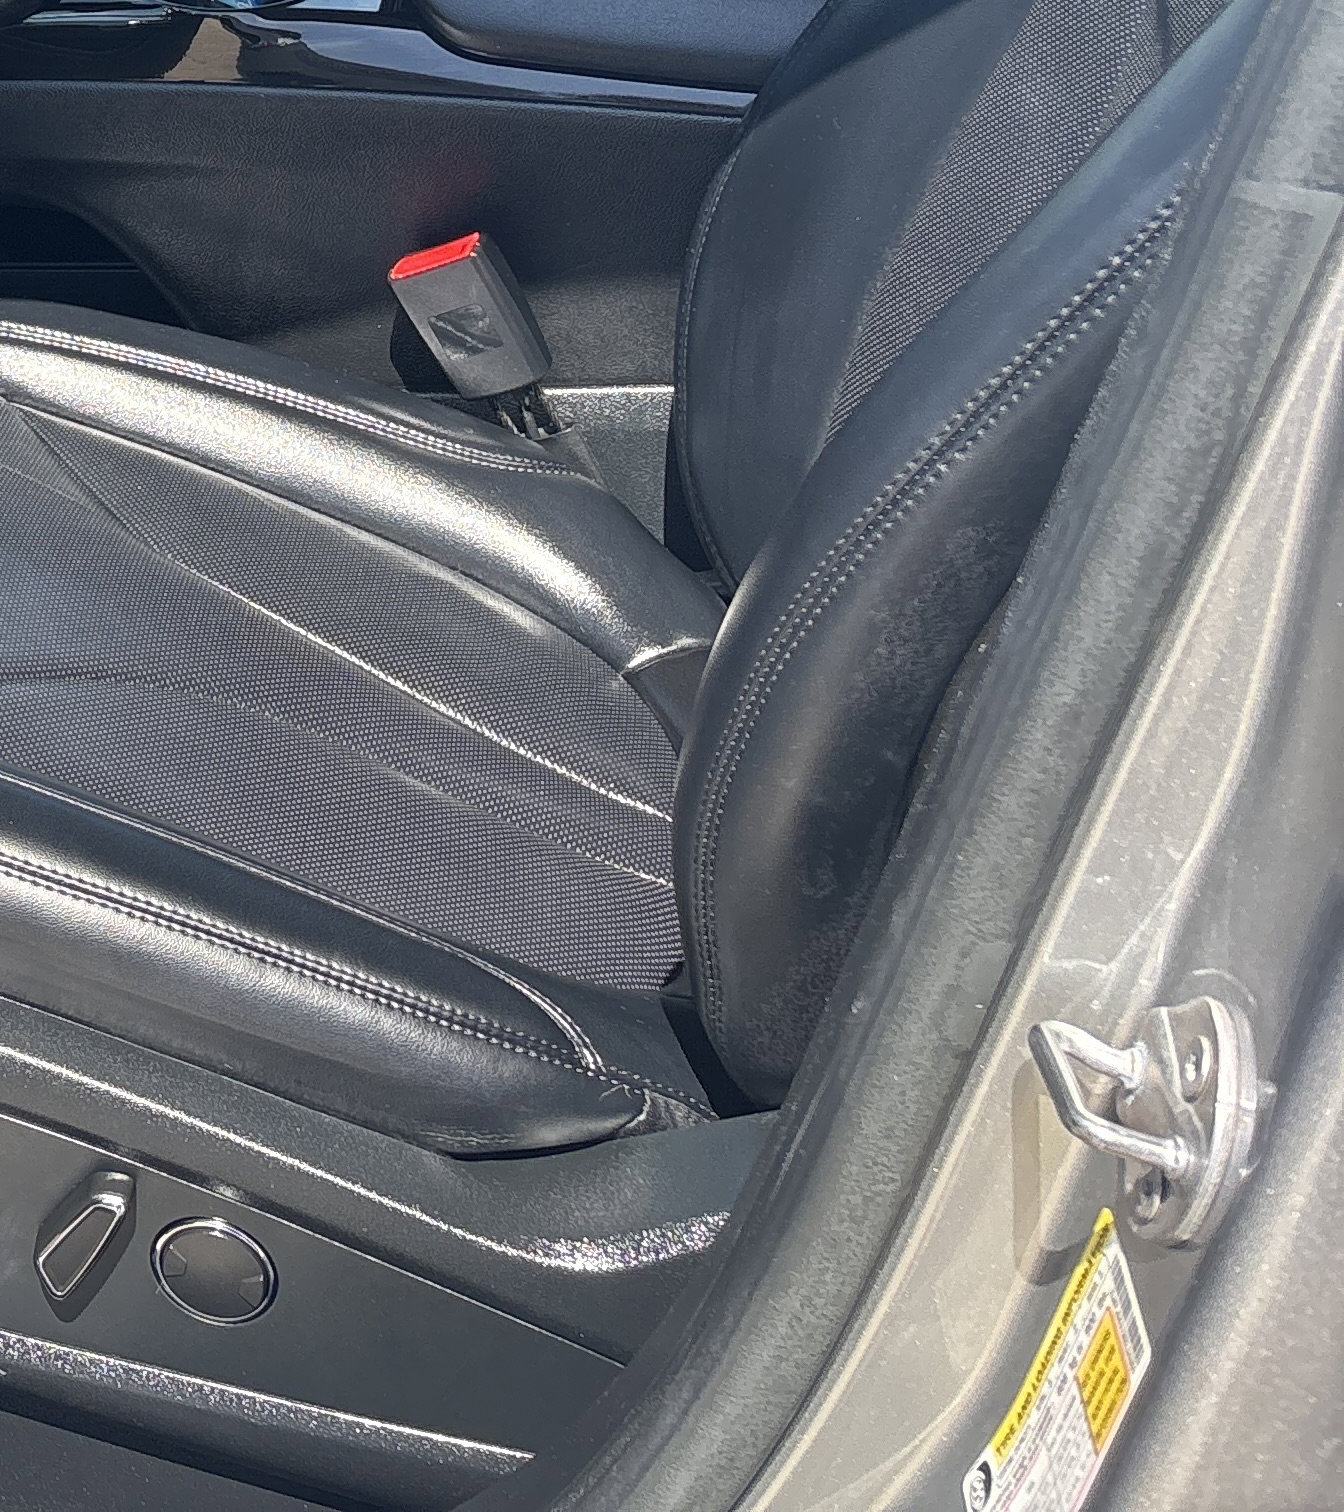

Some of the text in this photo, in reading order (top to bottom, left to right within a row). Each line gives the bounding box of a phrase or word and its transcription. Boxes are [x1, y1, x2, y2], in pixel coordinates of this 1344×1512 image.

[995, 1423, 1015, 1457] TIRE
[1016, 1392, 1032, 1425] AND
[1031, 1326, 1062, 1392] LOADING
